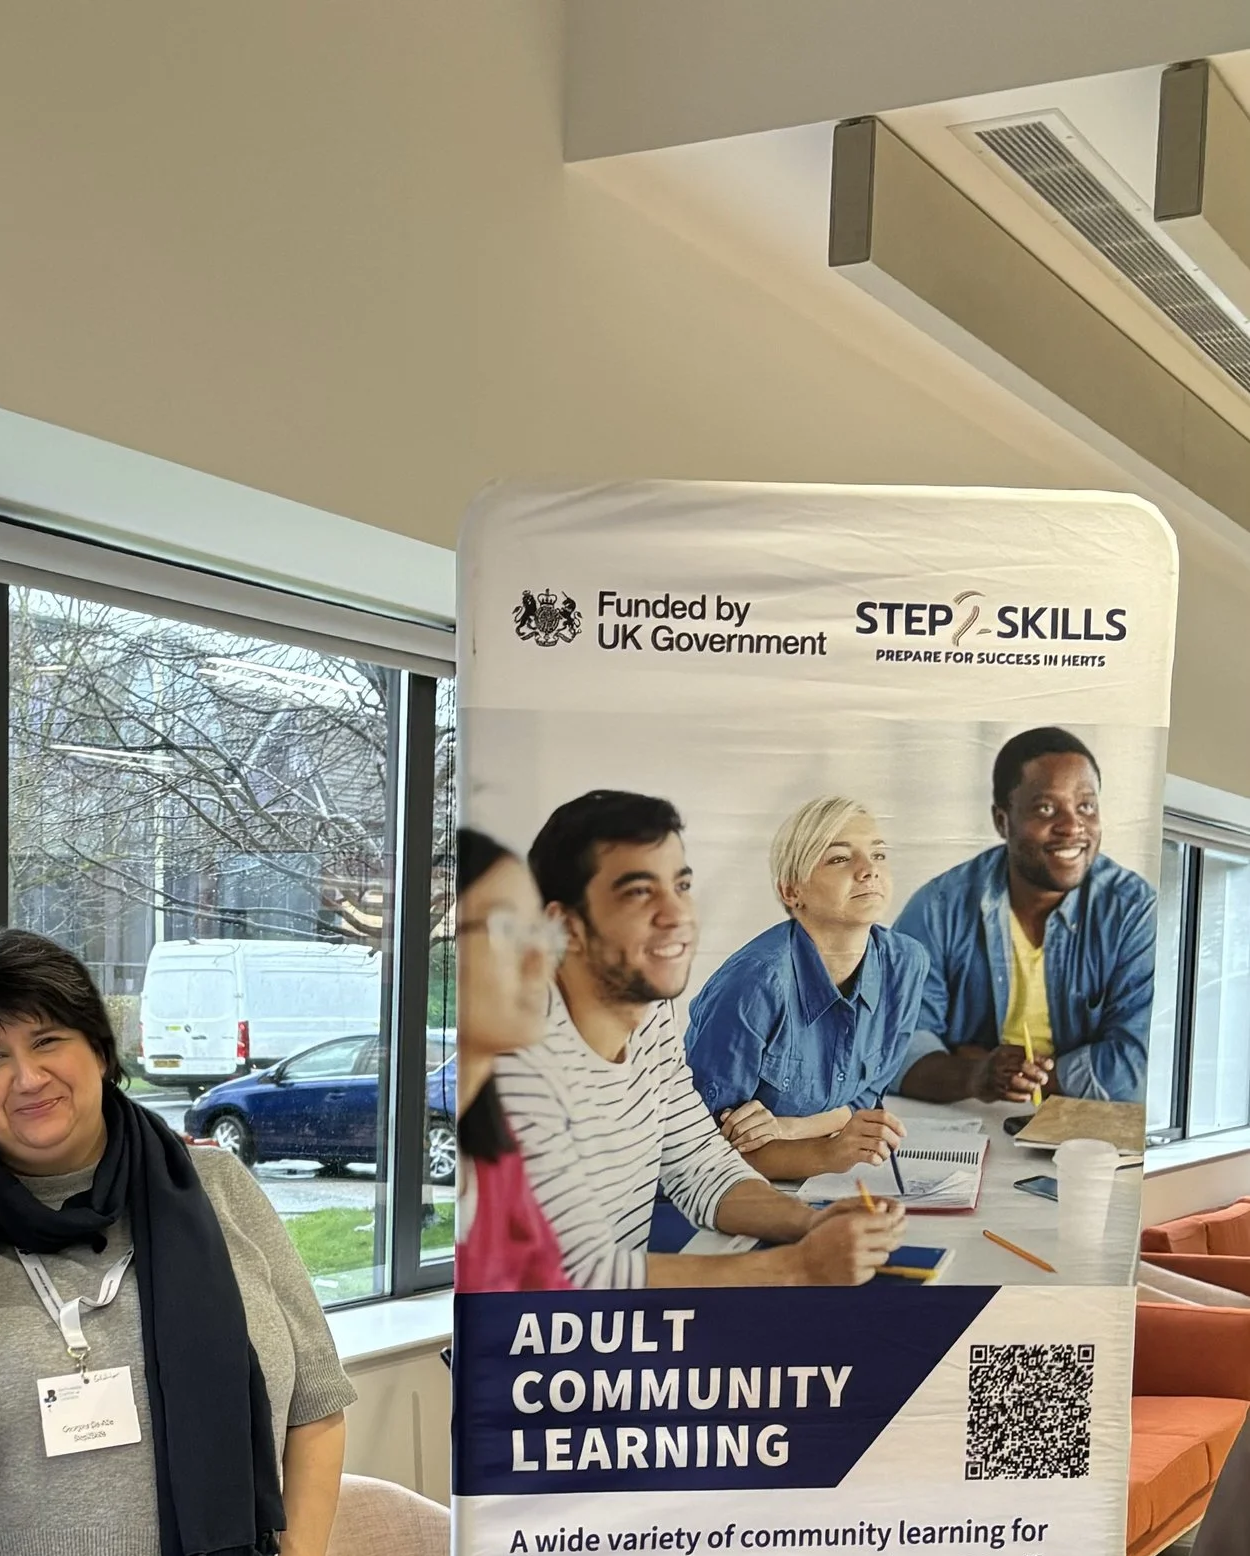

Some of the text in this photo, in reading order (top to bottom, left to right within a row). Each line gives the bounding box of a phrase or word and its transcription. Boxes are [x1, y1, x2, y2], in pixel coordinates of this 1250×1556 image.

[599, 591, 752, 628] Funded by
[598, 622, 827, 656] UK Government
[876, 648, 1106, 668] PREPARE FOR SUCCESS IN HERTS
[509, 1309, 696, 1356] ADULT
[511, 1365, 854, 1414] COMMUNITY
[511, 1423, 790, 1472] LEARNING
[510, 1517, 1049, 1556] A wide variety of community learning for
